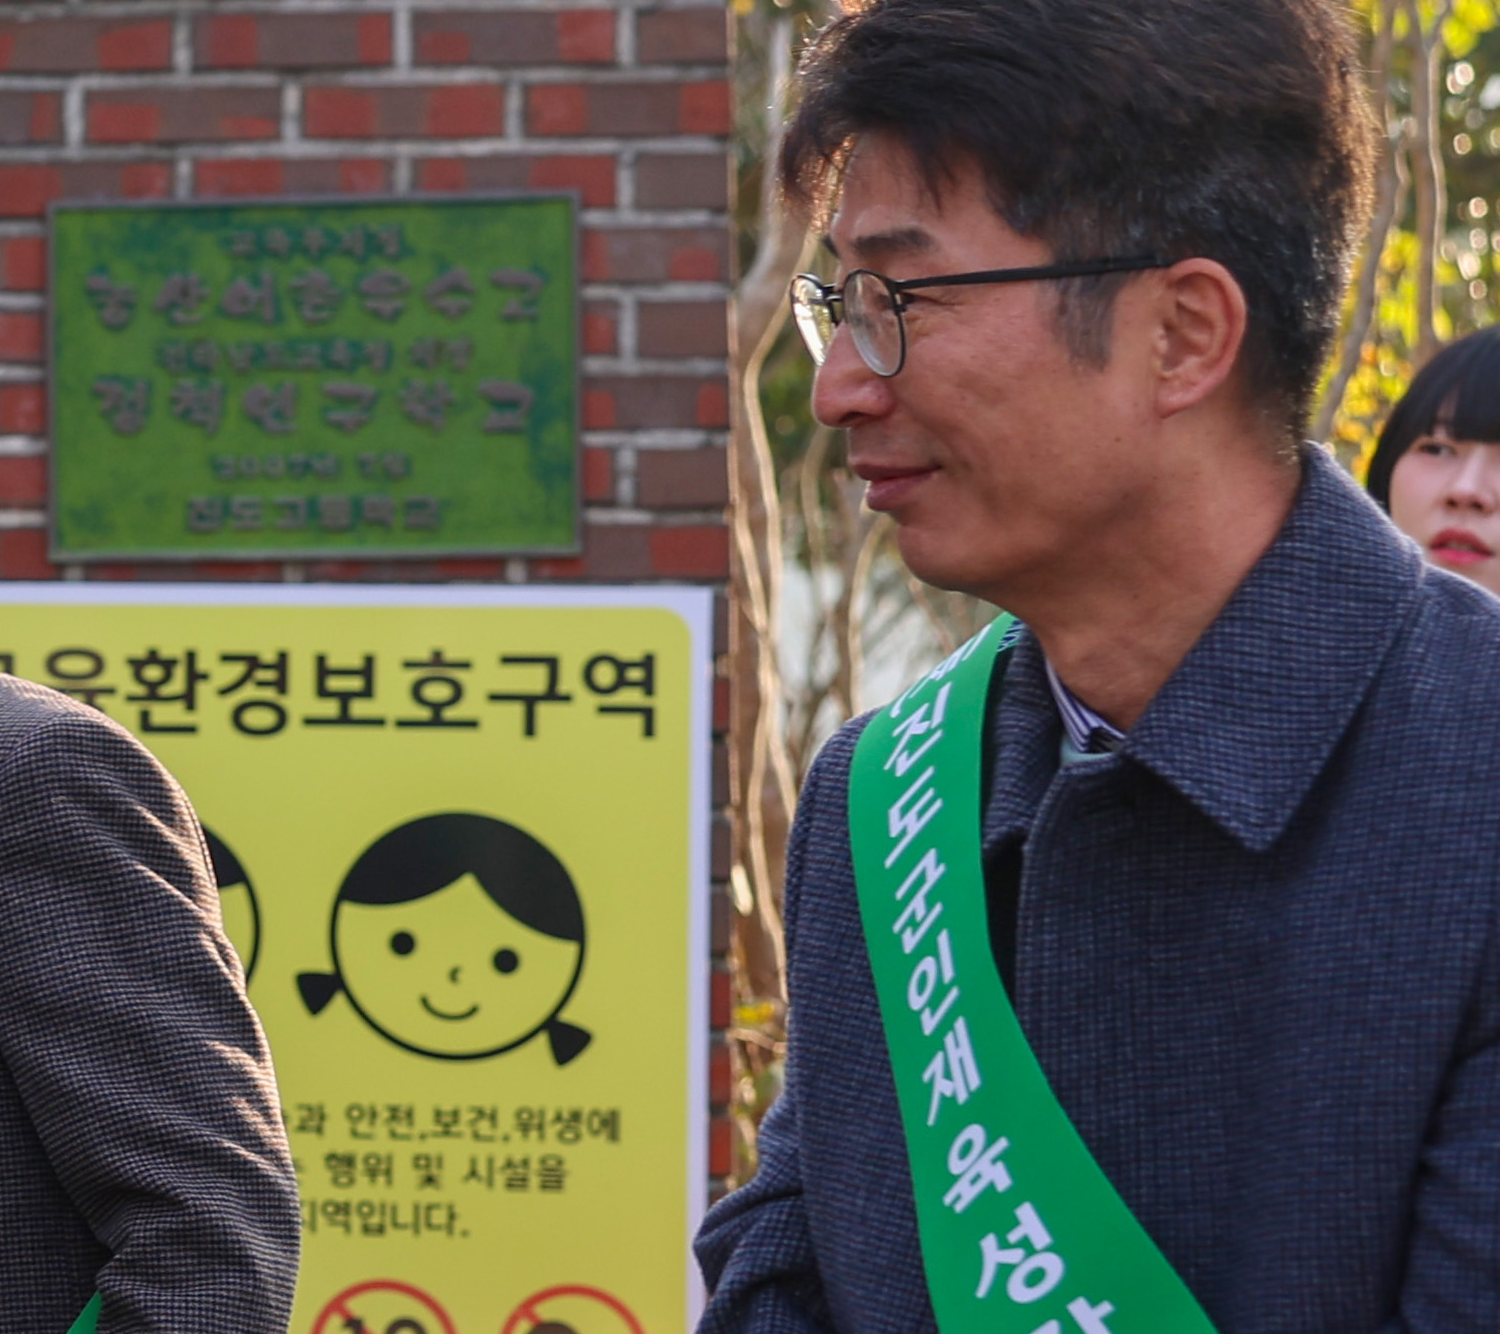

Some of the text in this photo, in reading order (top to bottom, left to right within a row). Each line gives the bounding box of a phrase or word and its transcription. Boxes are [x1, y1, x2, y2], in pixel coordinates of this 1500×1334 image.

[323, 1152, 395, 1189] 행위
[412, 1153, 443, 1190] 및
[463, 1154, 567, 1192] 시설을
